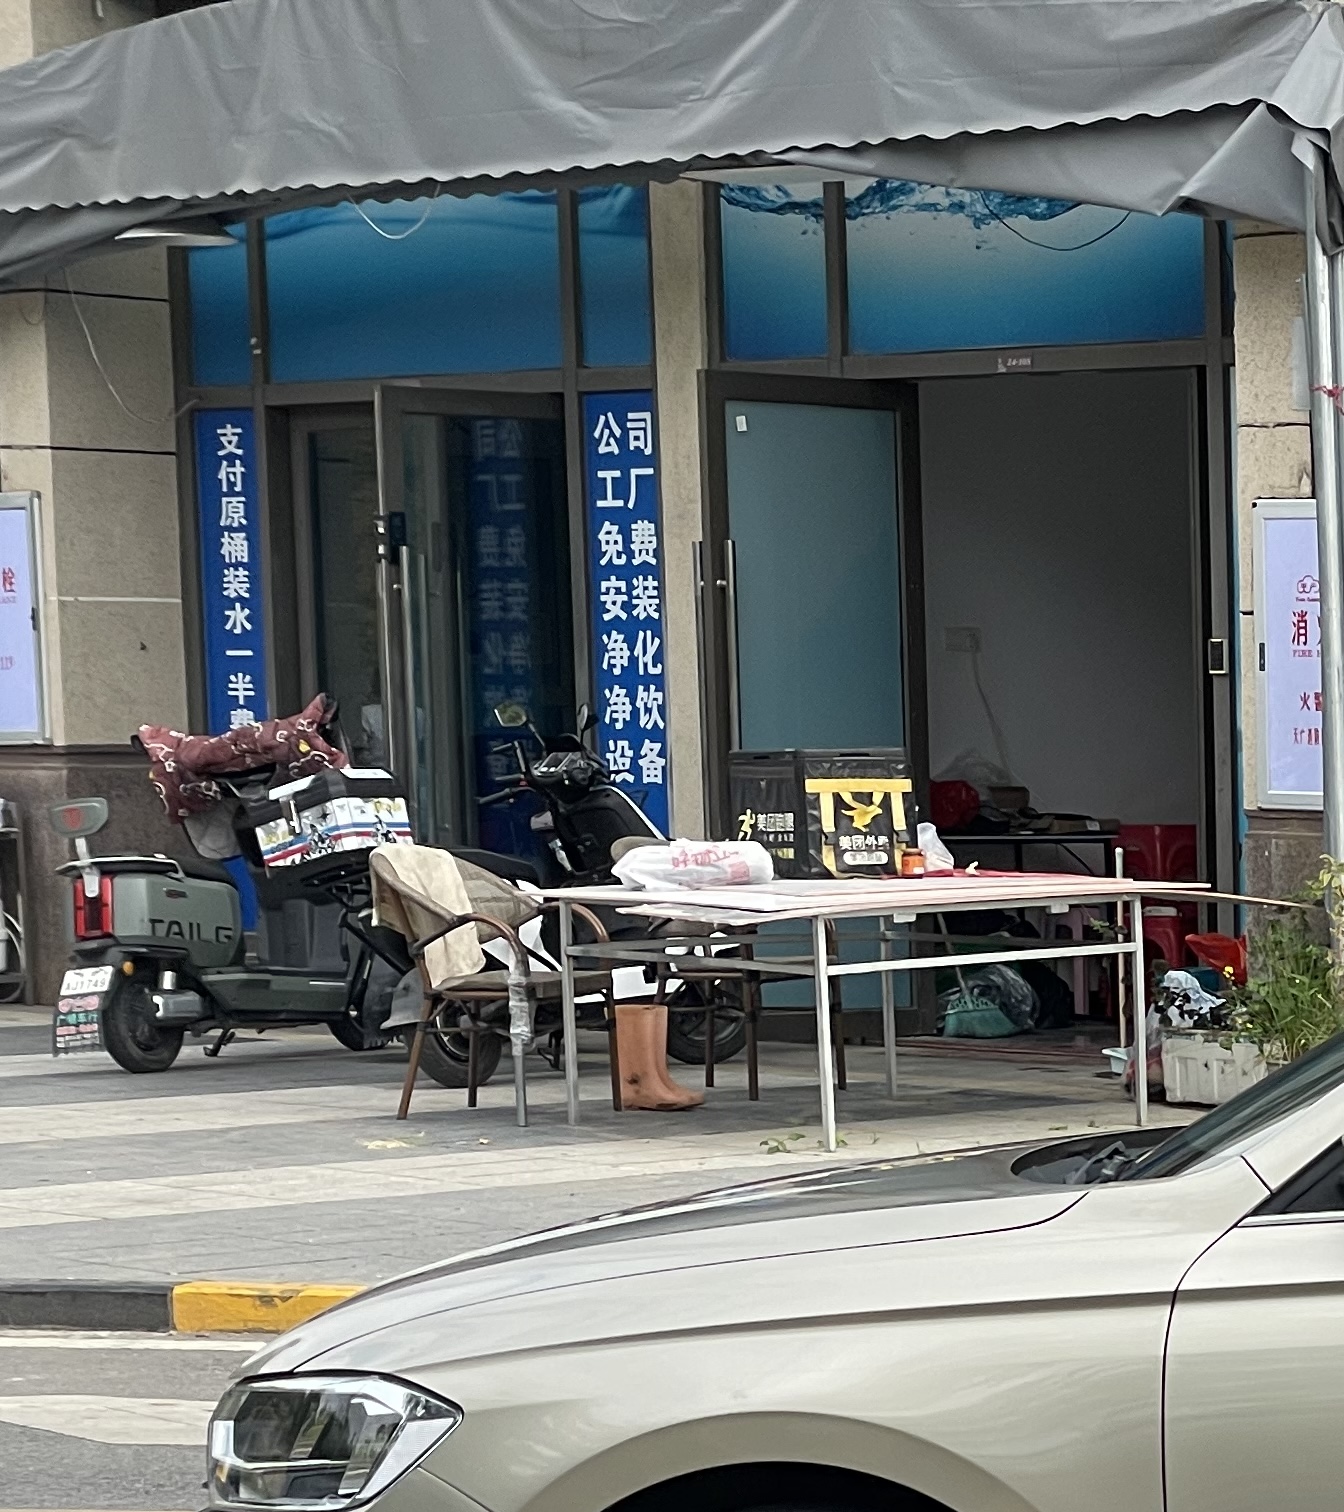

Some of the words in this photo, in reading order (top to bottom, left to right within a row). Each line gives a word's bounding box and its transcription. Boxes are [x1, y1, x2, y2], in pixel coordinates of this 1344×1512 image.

[594, 411, 653, 456] 公司
[597, 467, 654, 510] 工厂
[598, 520, 657, 567] 免费
[600, 575, 660, 621] 安装
[602, 630, 663, 676] 净化
[603, 684, 665, 730] 净饮
[605, 739, 666, 785] 设备
